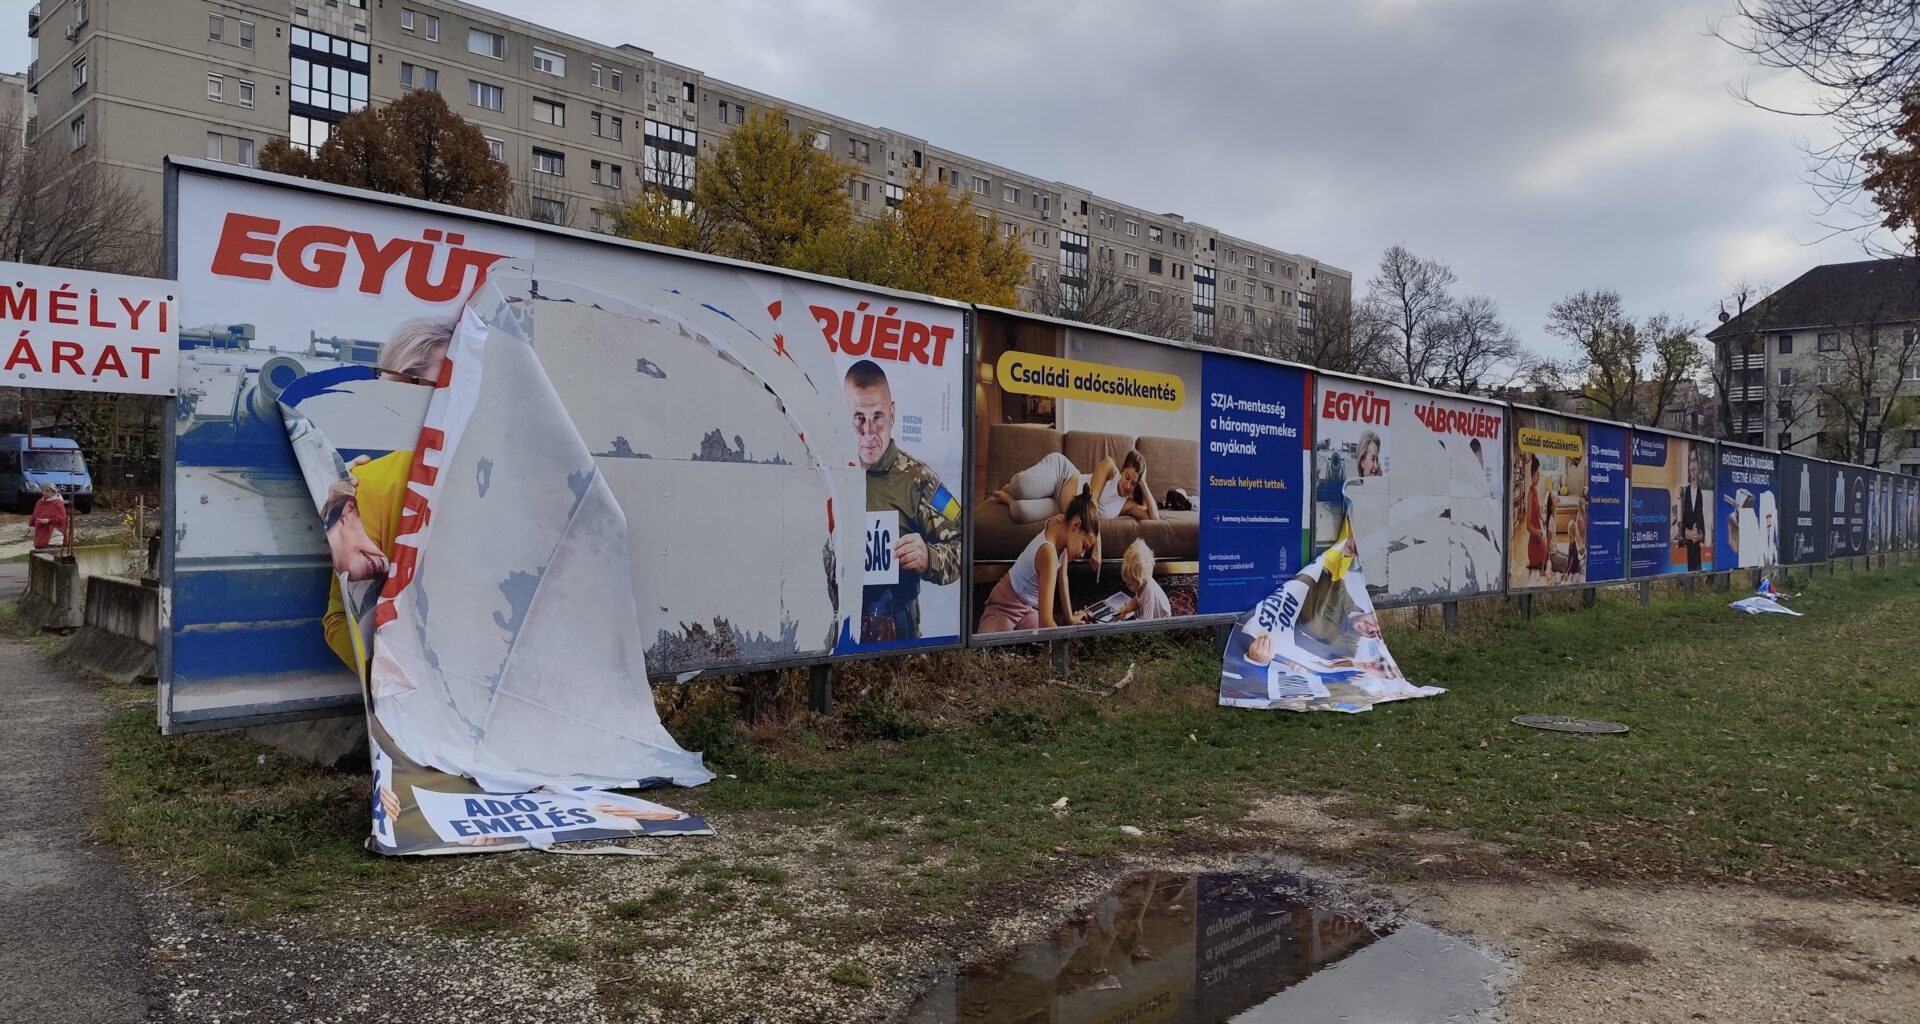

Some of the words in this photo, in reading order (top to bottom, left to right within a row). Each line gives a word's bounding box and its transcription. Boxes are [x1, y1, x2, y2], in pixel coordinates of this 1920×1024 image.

[0, 283, 167, 333] MÉLYI
[3, 329, 161, 380] ÁRAT
[1010, 361, 1070, 389] Családi
[1073, 372, 1177, 402] adócsökkentés
[1210, 392, 1286, 419] SZJA-mentesség
[1210, 418, 1217, 430] a
[1219, 416, 1297, 438] háromgyermekes
[1210, 439, 1257, 457] anyáknak
[1209, 475, 1237, 487] Szavak
[1238, 477, 1262, 490] helyett
[1264, 479, 1287, 490] tettek.
[463, 795, 553, 818] ADÓ-
[449, 806, 598, 837] EMELÉS
